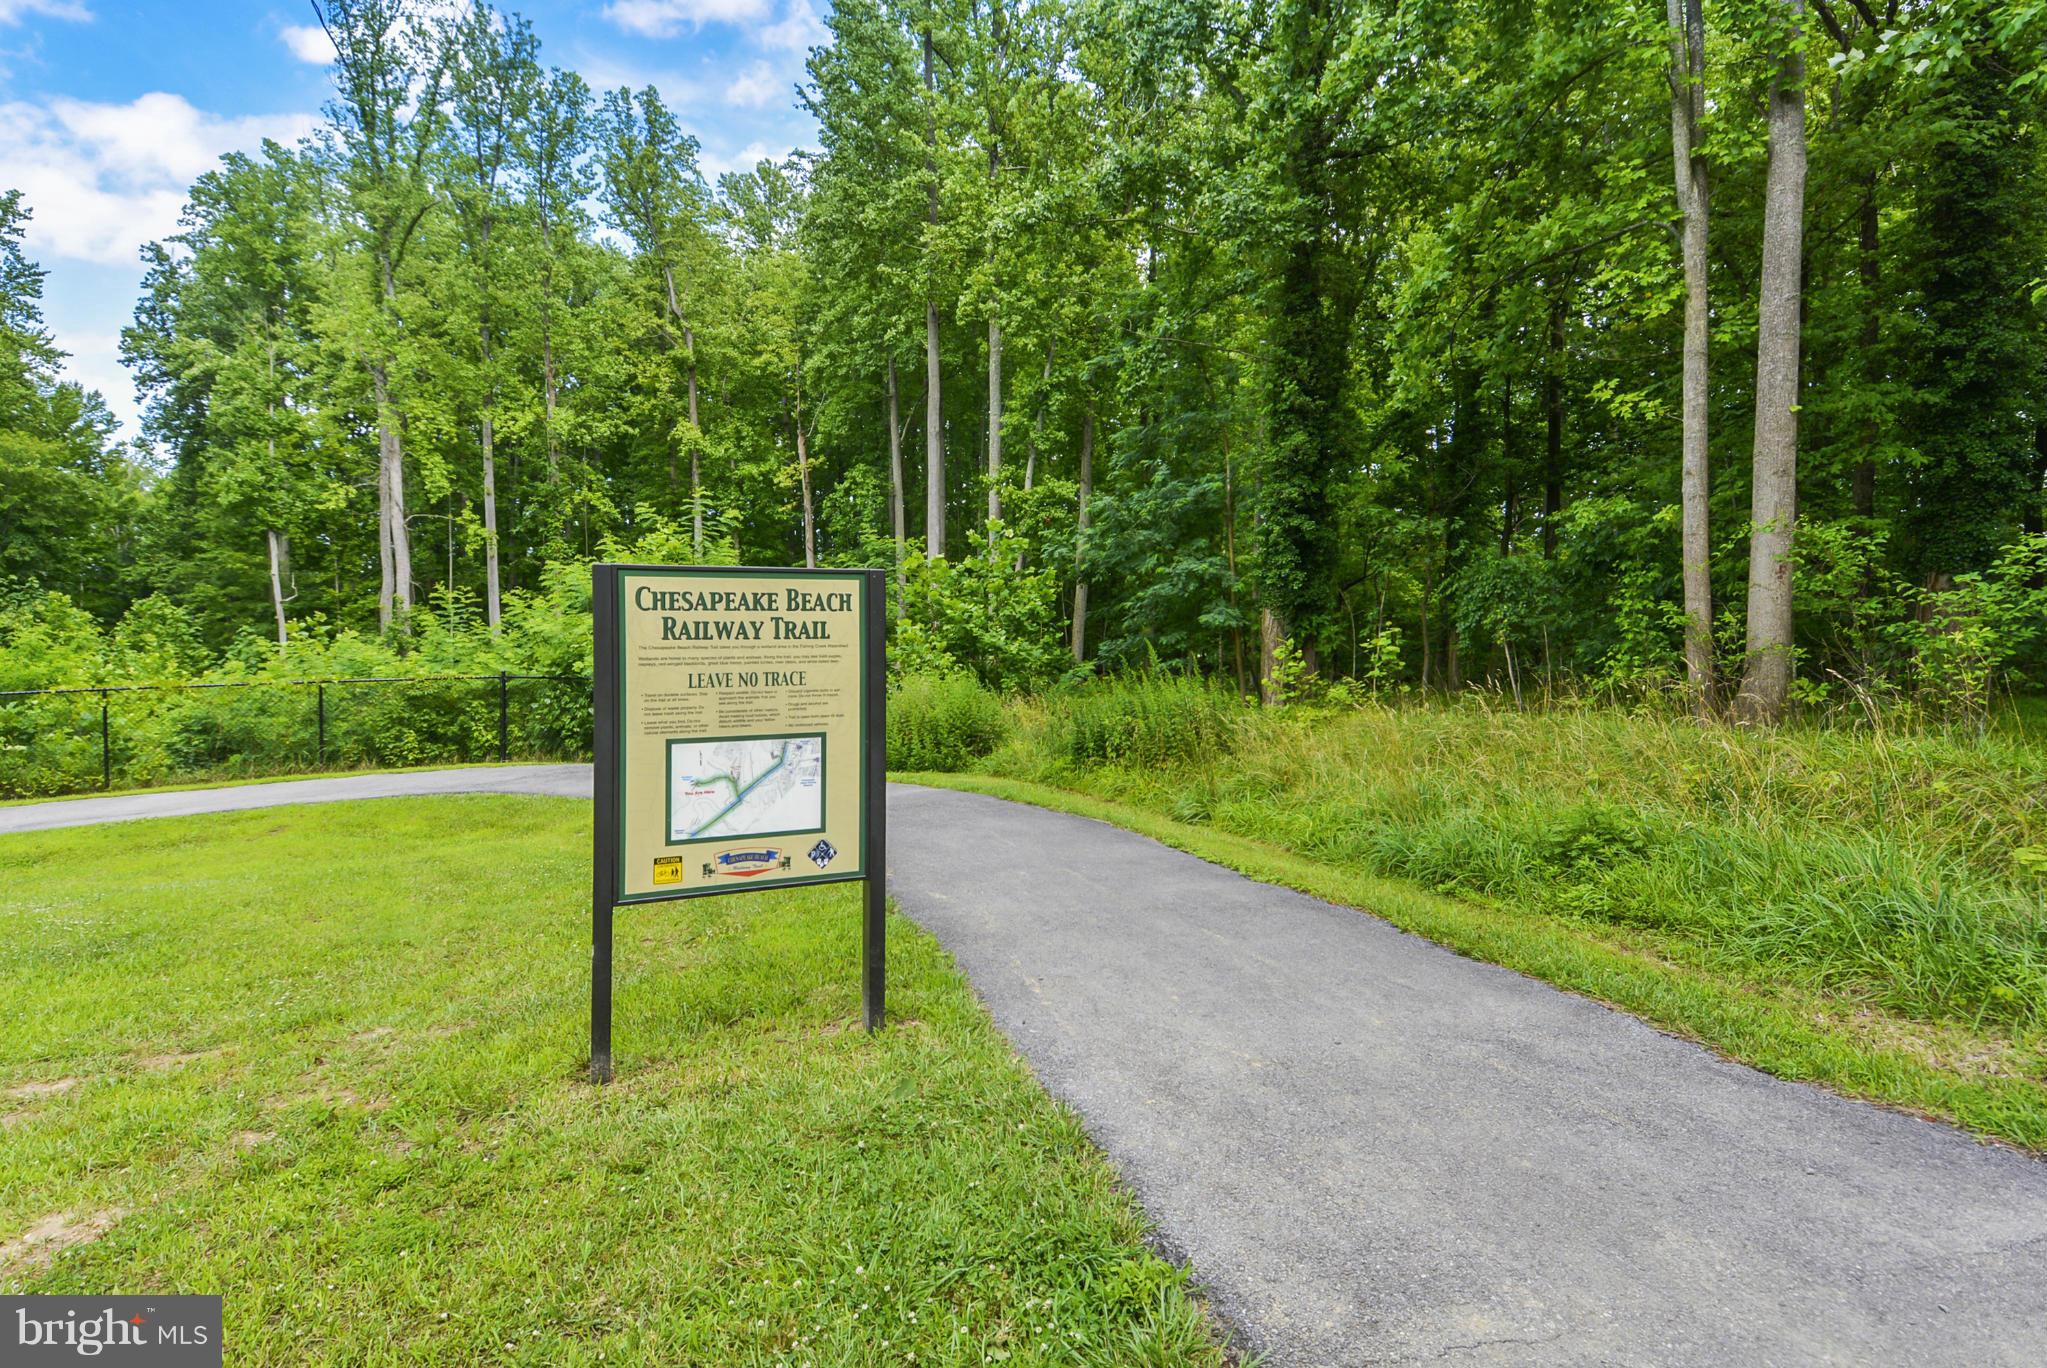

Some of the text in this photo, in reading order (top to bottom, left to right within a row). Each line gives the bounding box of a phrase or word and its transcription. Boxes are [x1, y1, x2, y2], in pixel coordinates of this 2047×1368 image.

[635, 586, 853, 612] CHESAPEAKE BEACH
[661, 616, 831, 641] RAILWAY TRAIL
[688, 671, 807, 689] LEAVE NO TRACE
[656, 857, 680, 865] CAUTION
